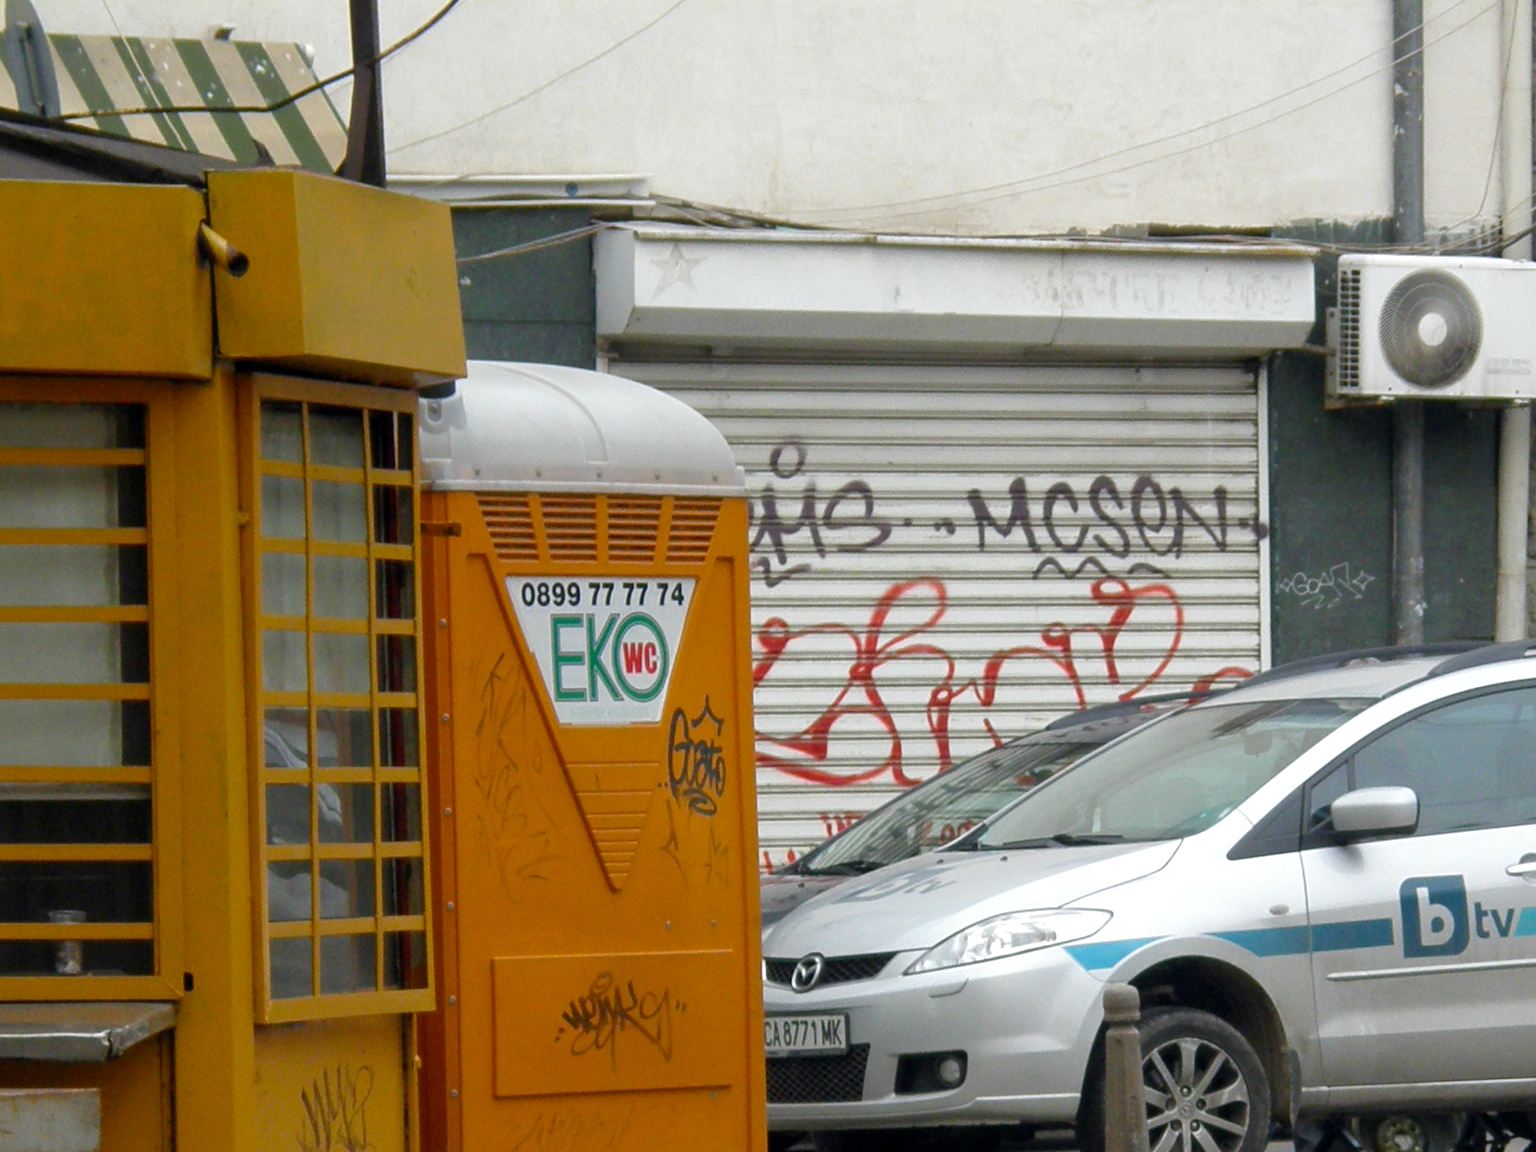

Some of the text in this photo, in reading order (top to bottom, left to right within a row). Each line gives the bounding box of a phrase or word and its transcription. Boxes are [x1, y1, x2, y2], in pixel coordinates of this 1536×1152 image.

[521, 582, 684, 607] 0899 77 77 74
[550, 611, 670, 703] EKO
[622, 642, 658, 675] WC
